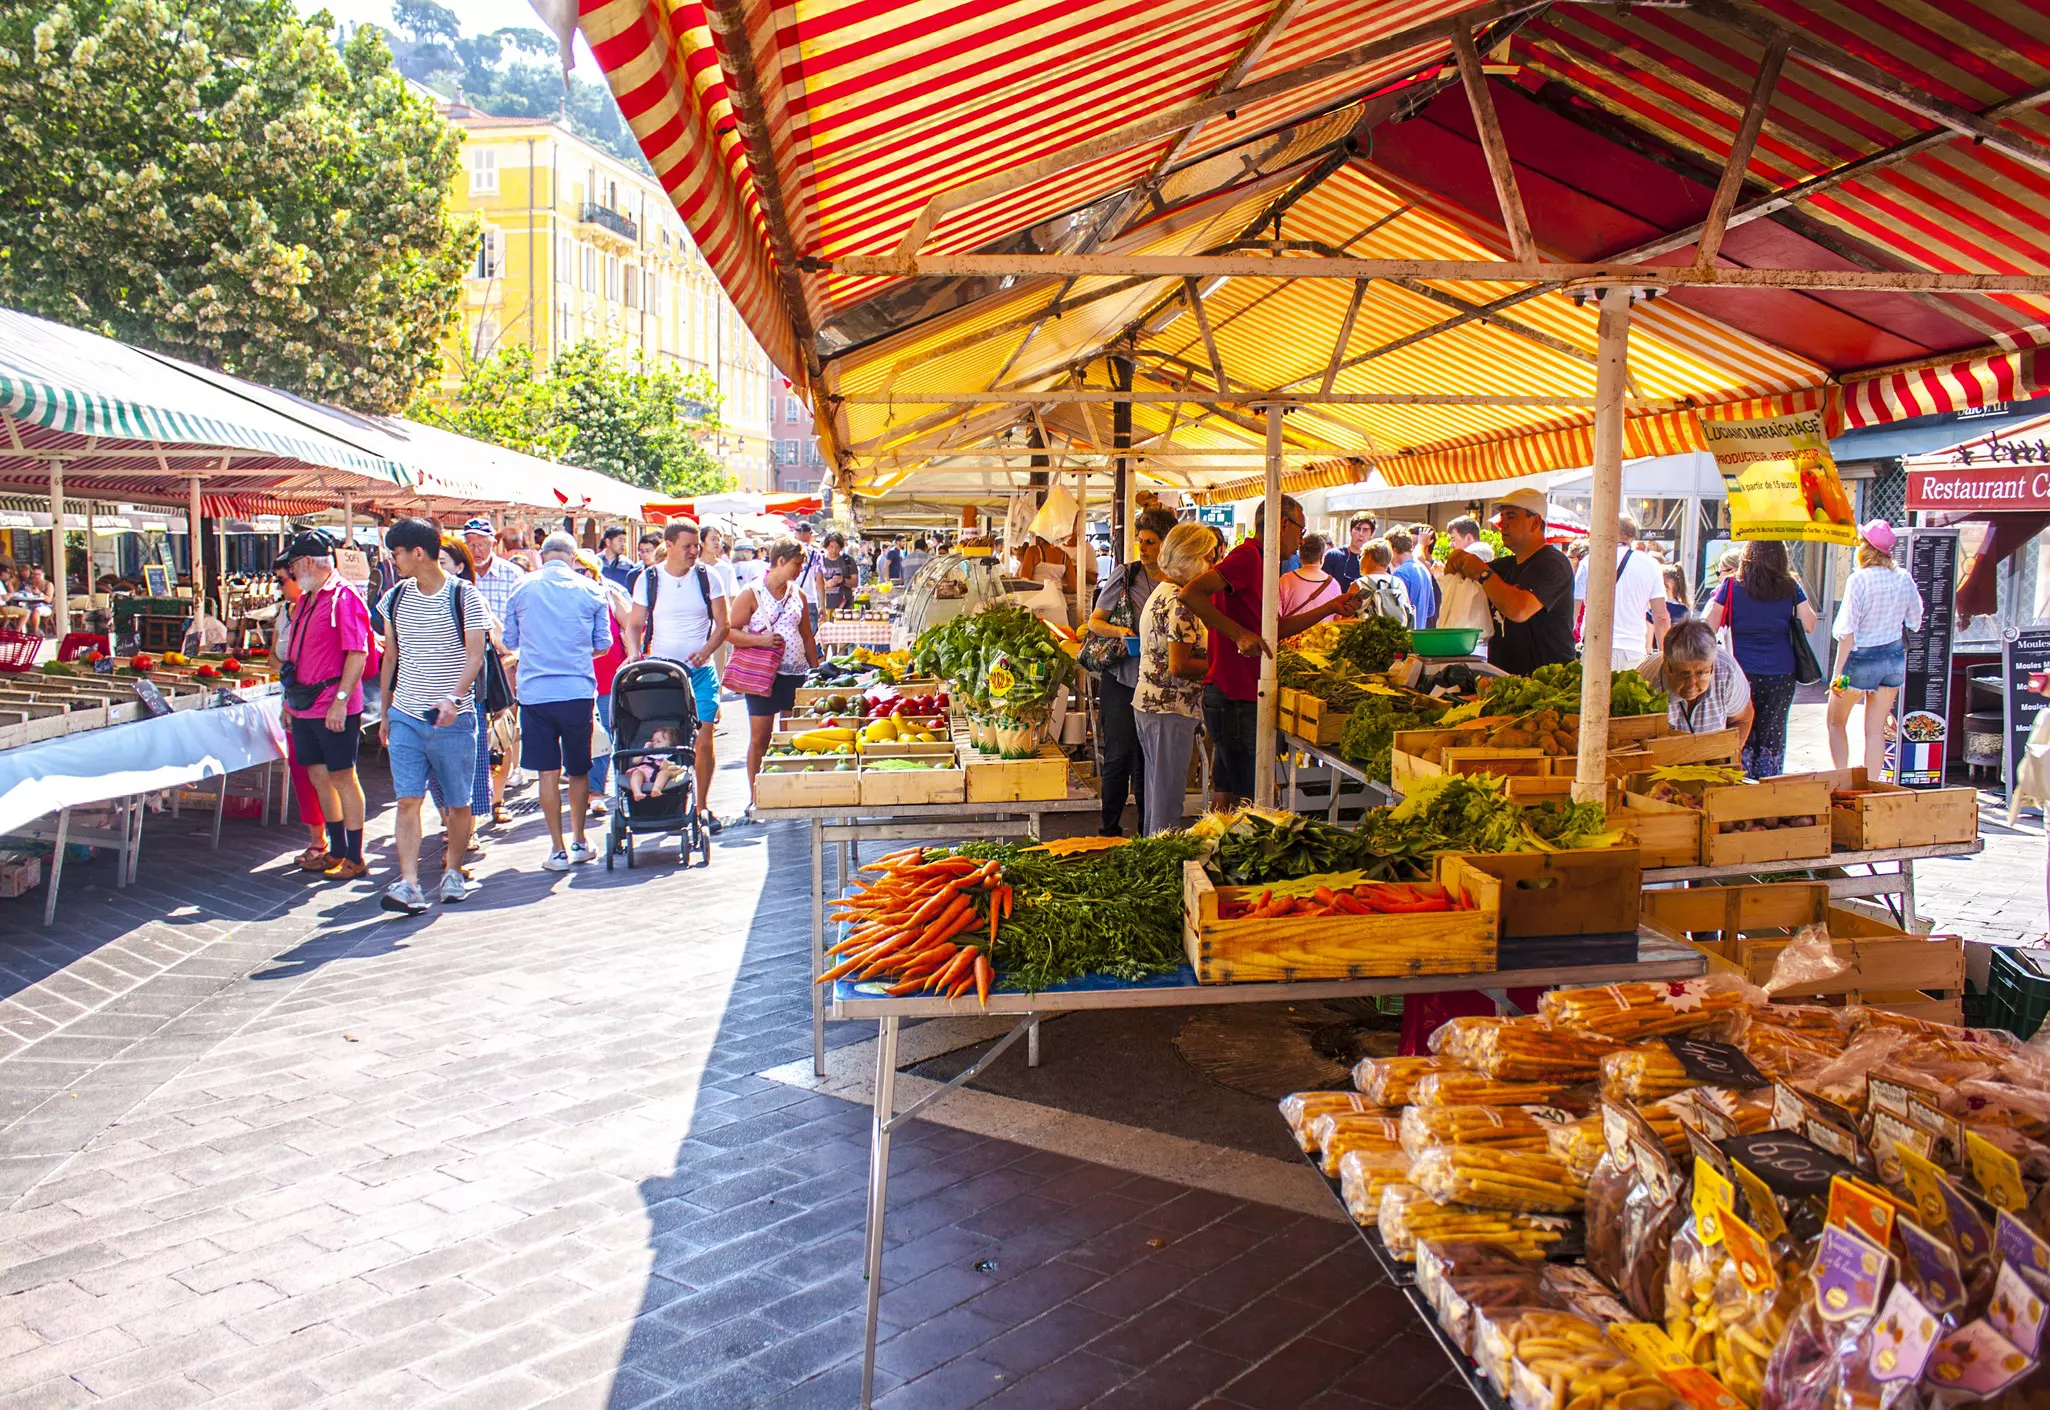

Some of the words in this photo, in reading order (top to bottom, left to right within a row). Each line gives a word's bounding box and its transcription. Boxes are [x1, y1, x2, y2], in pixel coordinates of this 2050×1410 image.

[1704, 424, 1748, 441] LUCIANO
[1746, 419, 1821, 440] MARAÎCHAGE
[1716, 451, 1768, 465] PRODUCTEUR
[1771, 448, 1820, 462] REVENDEUR
[1746, 480, 1764, 493] partir
[1764, 480, 1772, 489] de
[1773, 481, 1780, 490] 15
[1781, 481, 1798, 490] euros
[1921, 476, 2027, 500] Restaurant
[2017, 639, 2050, 649] Moules
[2016, 662, 2042, 670] Moules
[2016, 724, 2033, 732] Moul
